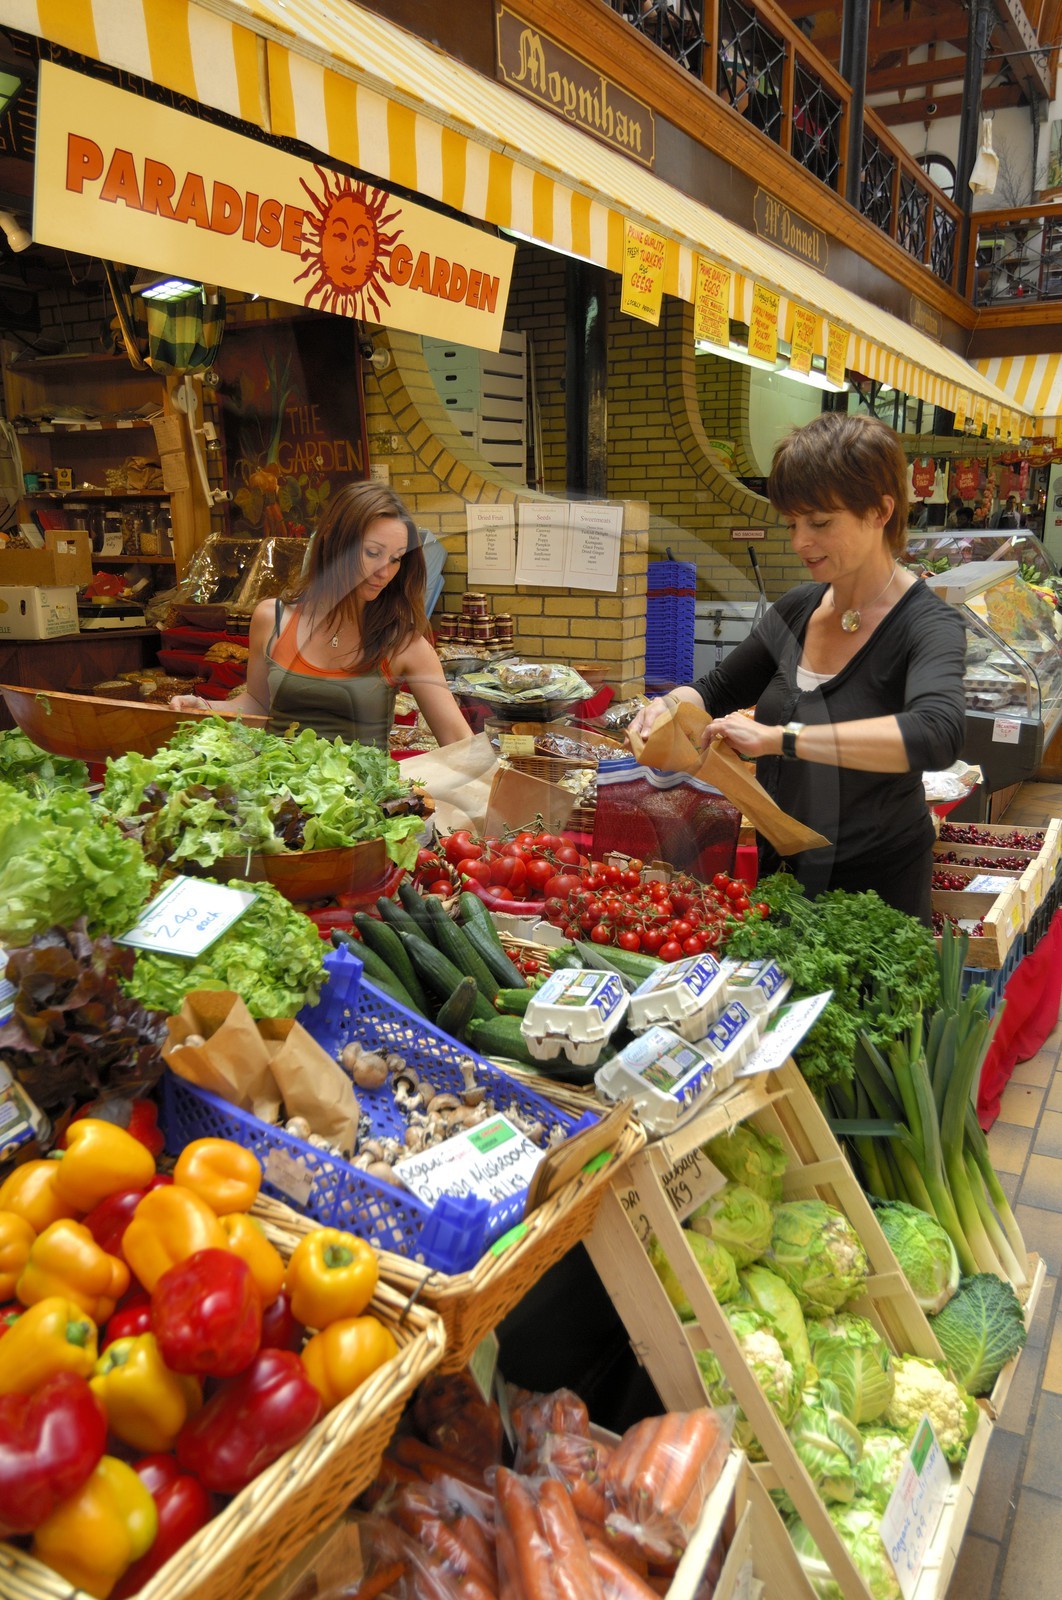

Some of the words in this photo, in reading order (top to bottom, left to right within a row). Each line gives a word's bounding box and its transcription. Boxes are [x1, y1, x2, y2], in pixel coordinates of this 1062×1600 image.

[512, 28, 642, 153] Moynihan
[65, 132, 305, 255] PARADISE
[628, 225, 644, 244] PRIME
[644, 234, 665, 254] QUALITY
[640, 249, 664, 271] TURKEYS
[388, 243, 501, 315] GARDEN
[631, 273, 654, 294] GEESE
[704, 279, 721, 297] EGGS
[286, 404, 325, 436] THE
[276, 440, 364, 474] GARDEN
[580, 515, 611, 524] Sweetmeats
[196, 911, 220, 932] each
